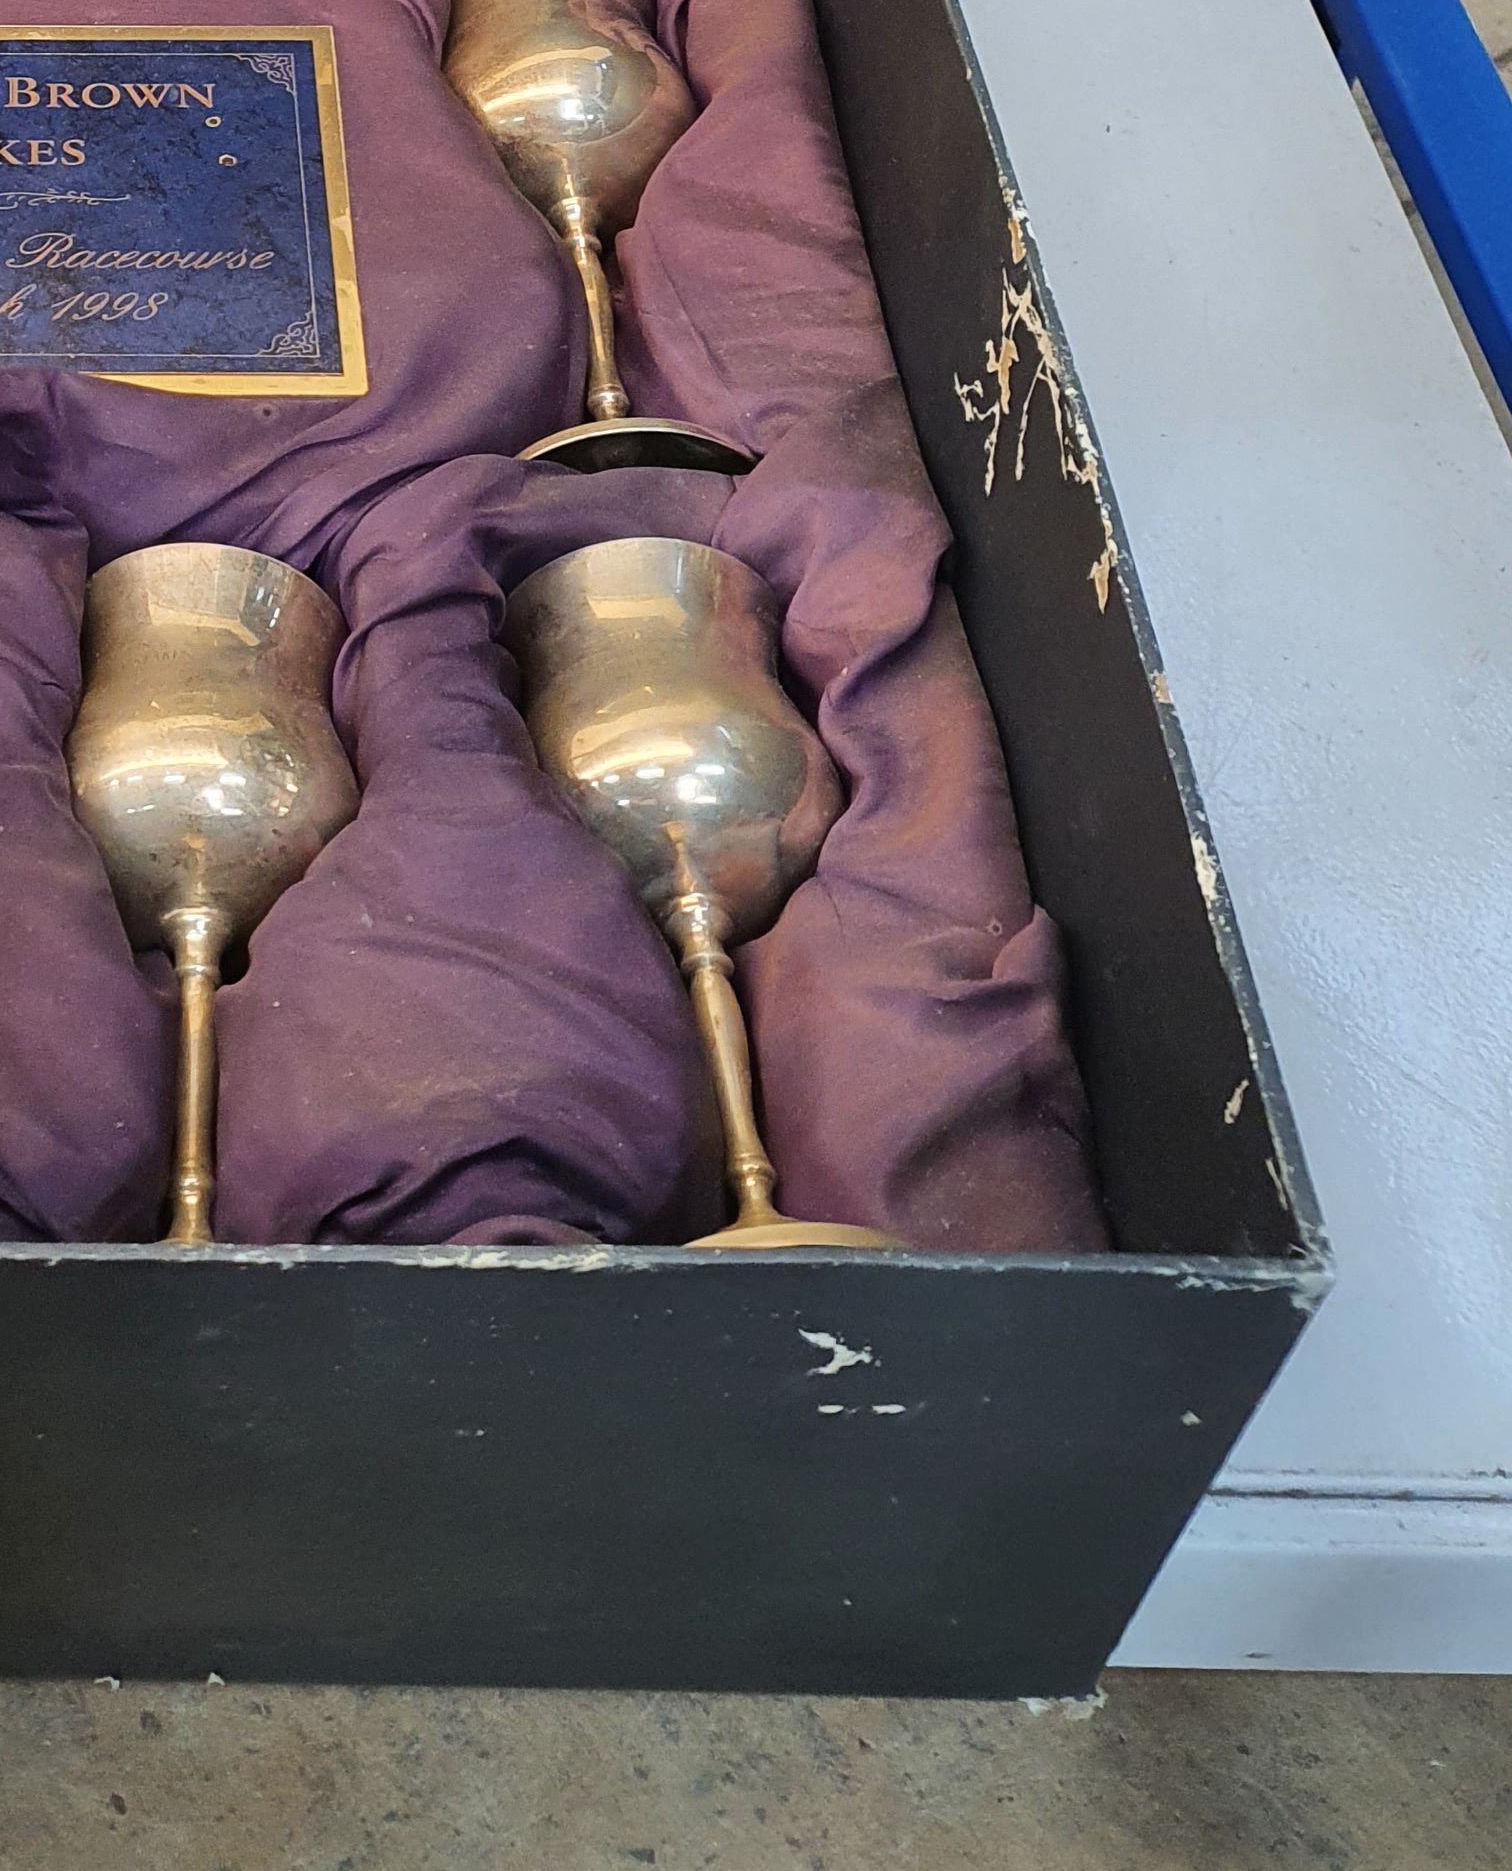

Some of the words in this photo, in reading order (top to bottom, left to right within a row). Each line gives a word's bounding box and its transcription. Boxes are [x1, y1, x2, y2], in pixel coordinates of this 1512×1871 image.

[3, 76, 216, 109] BROWN
[5, 233, 276, 270] Racecourse
[51, 289, 170, 321] 1998
